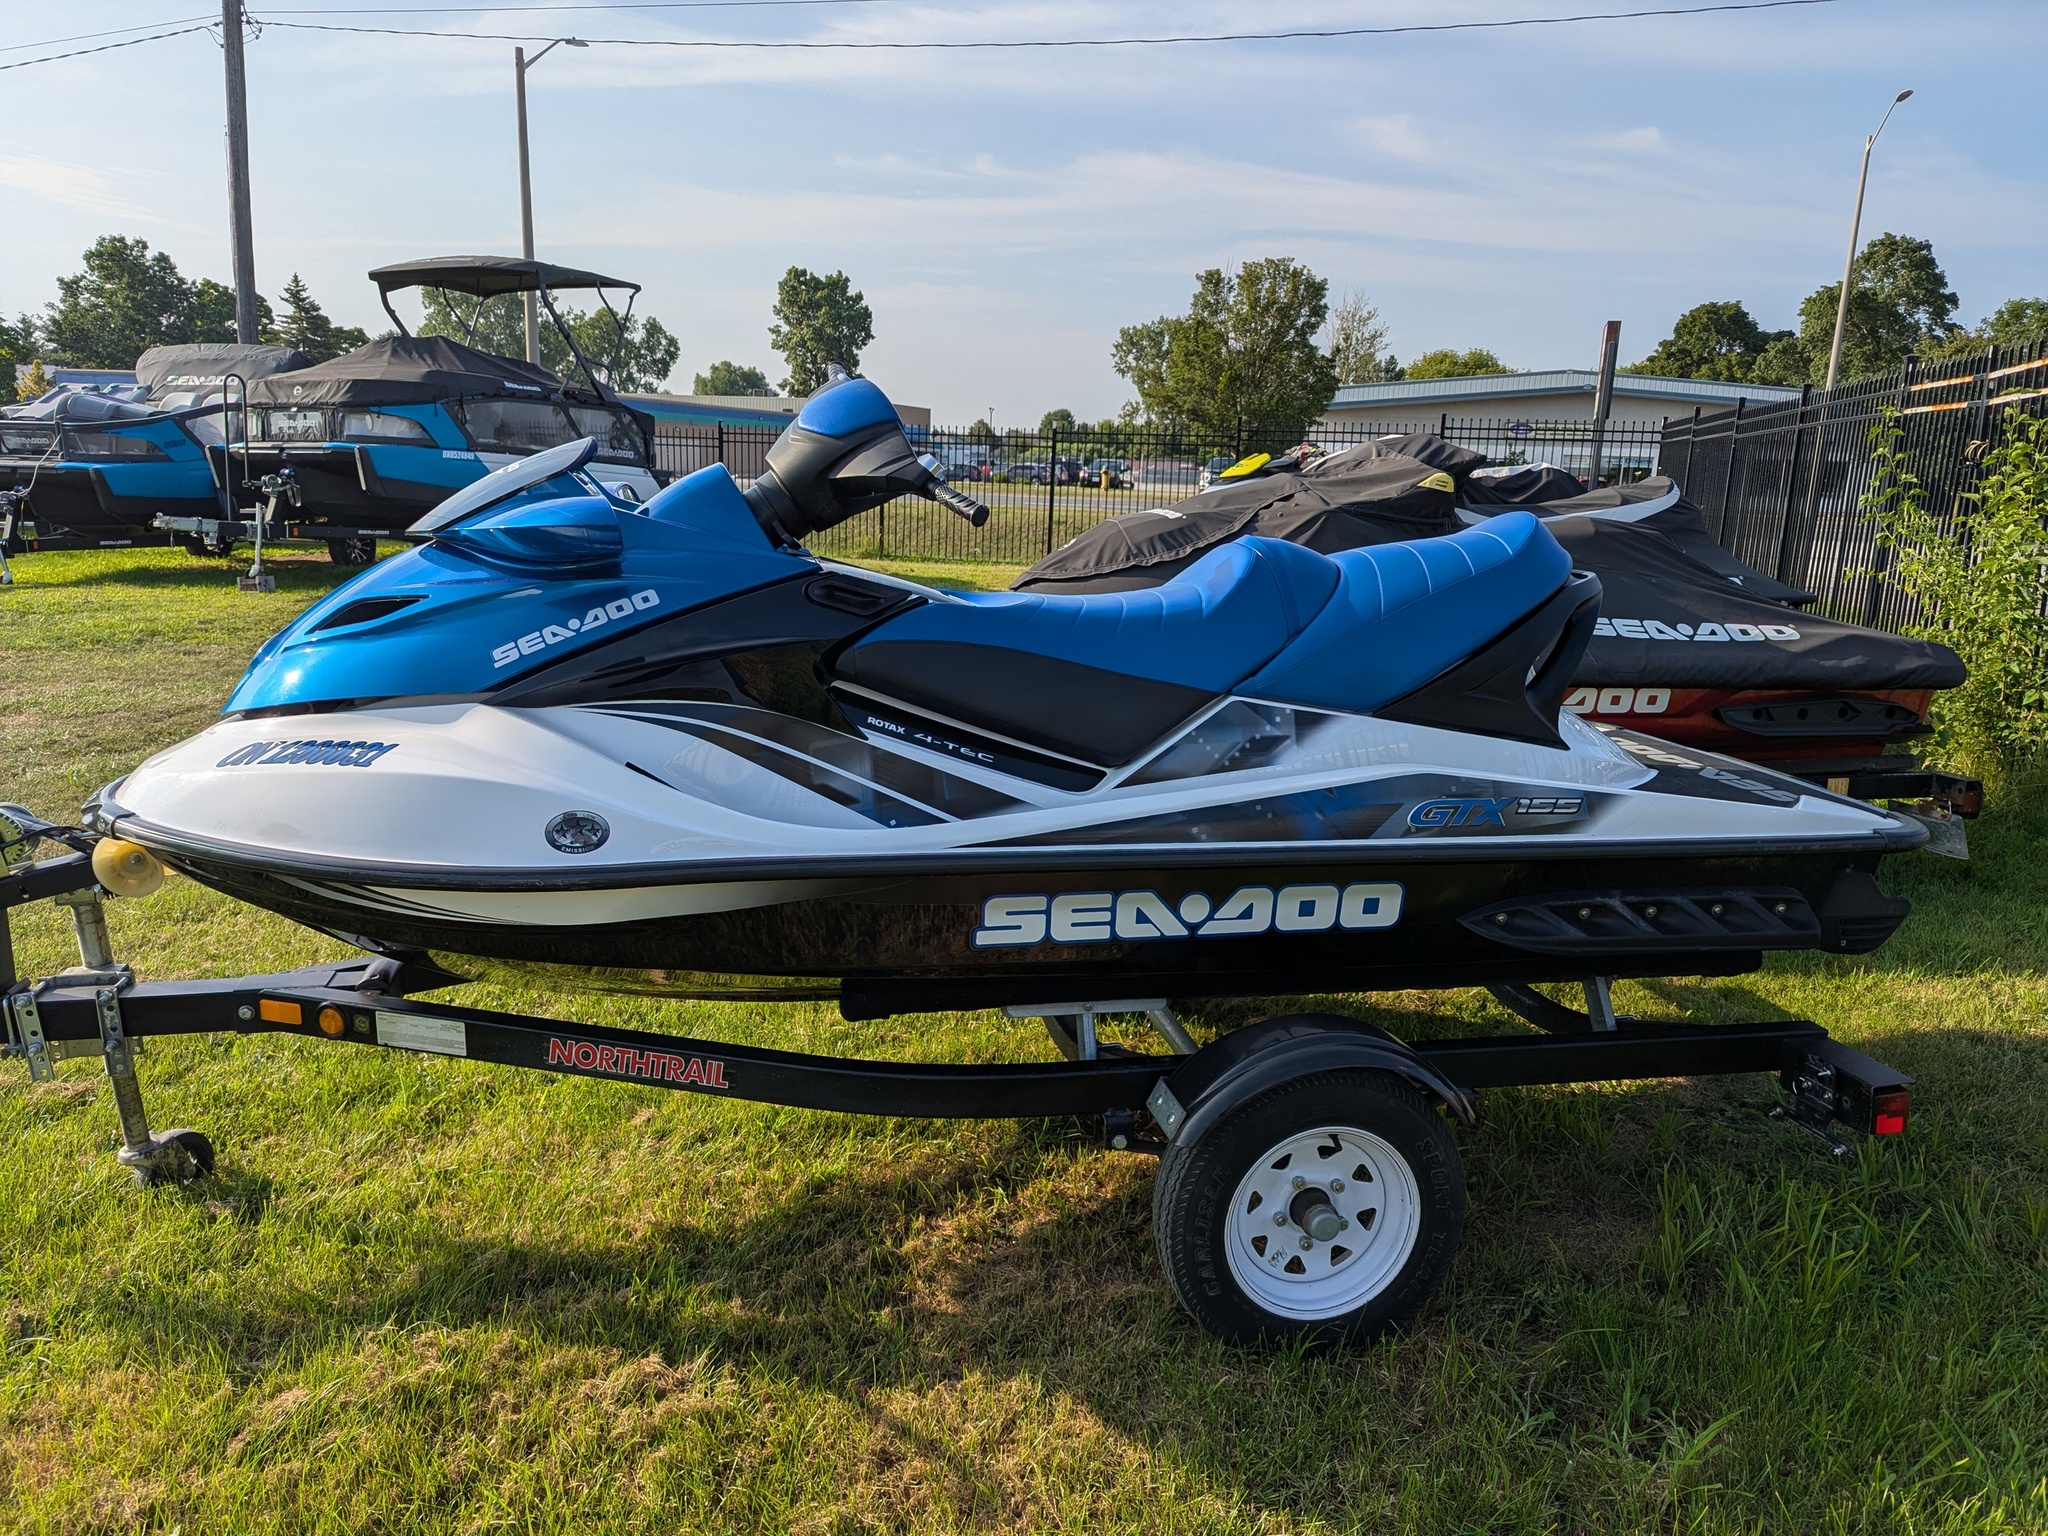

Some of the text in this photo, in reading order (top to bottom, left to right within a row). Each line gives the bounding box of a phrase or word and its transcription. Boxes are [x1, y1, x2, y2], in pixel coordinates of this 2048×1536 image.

[866, 716, 995, 763] ROTAX 4-TEC
[1406, 797, 1586, 828] GTX 155
[560, 844, 596, 854] EMISSION
[548, 1037, 730, 1090] NORTHTRAIL
